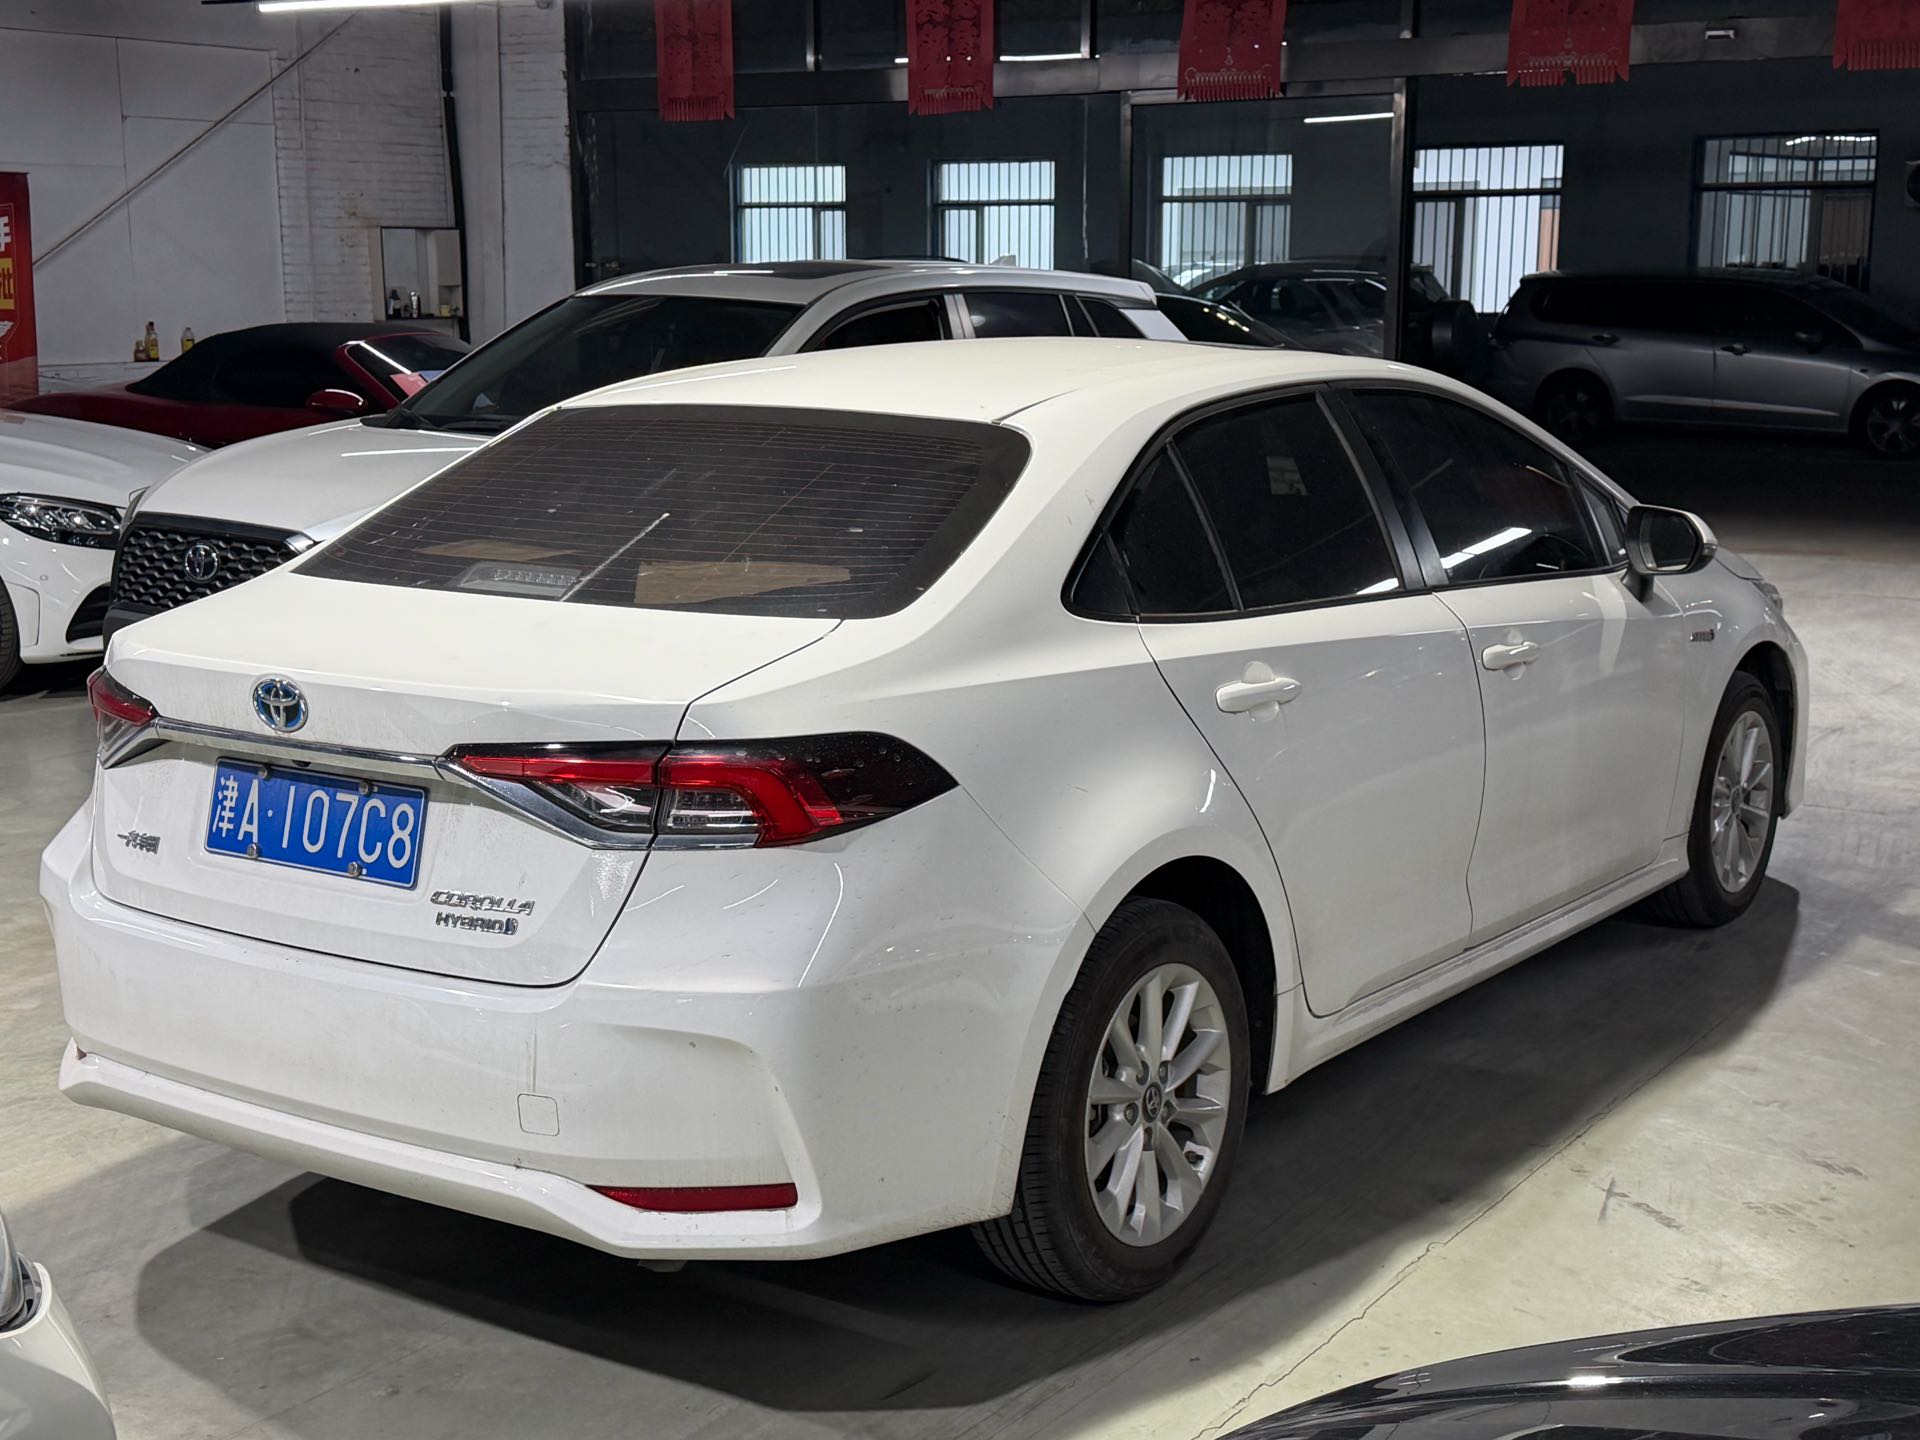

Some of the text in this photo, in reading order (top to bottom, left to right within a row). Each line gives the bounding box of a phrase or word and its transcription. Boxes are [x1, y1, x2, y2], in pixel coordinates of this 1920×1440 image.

[212, 775, 415, 869] 津A·107C8
[430, 890, 535, 916] COROLLA
[435, 911, 505, 934] HYBRID
